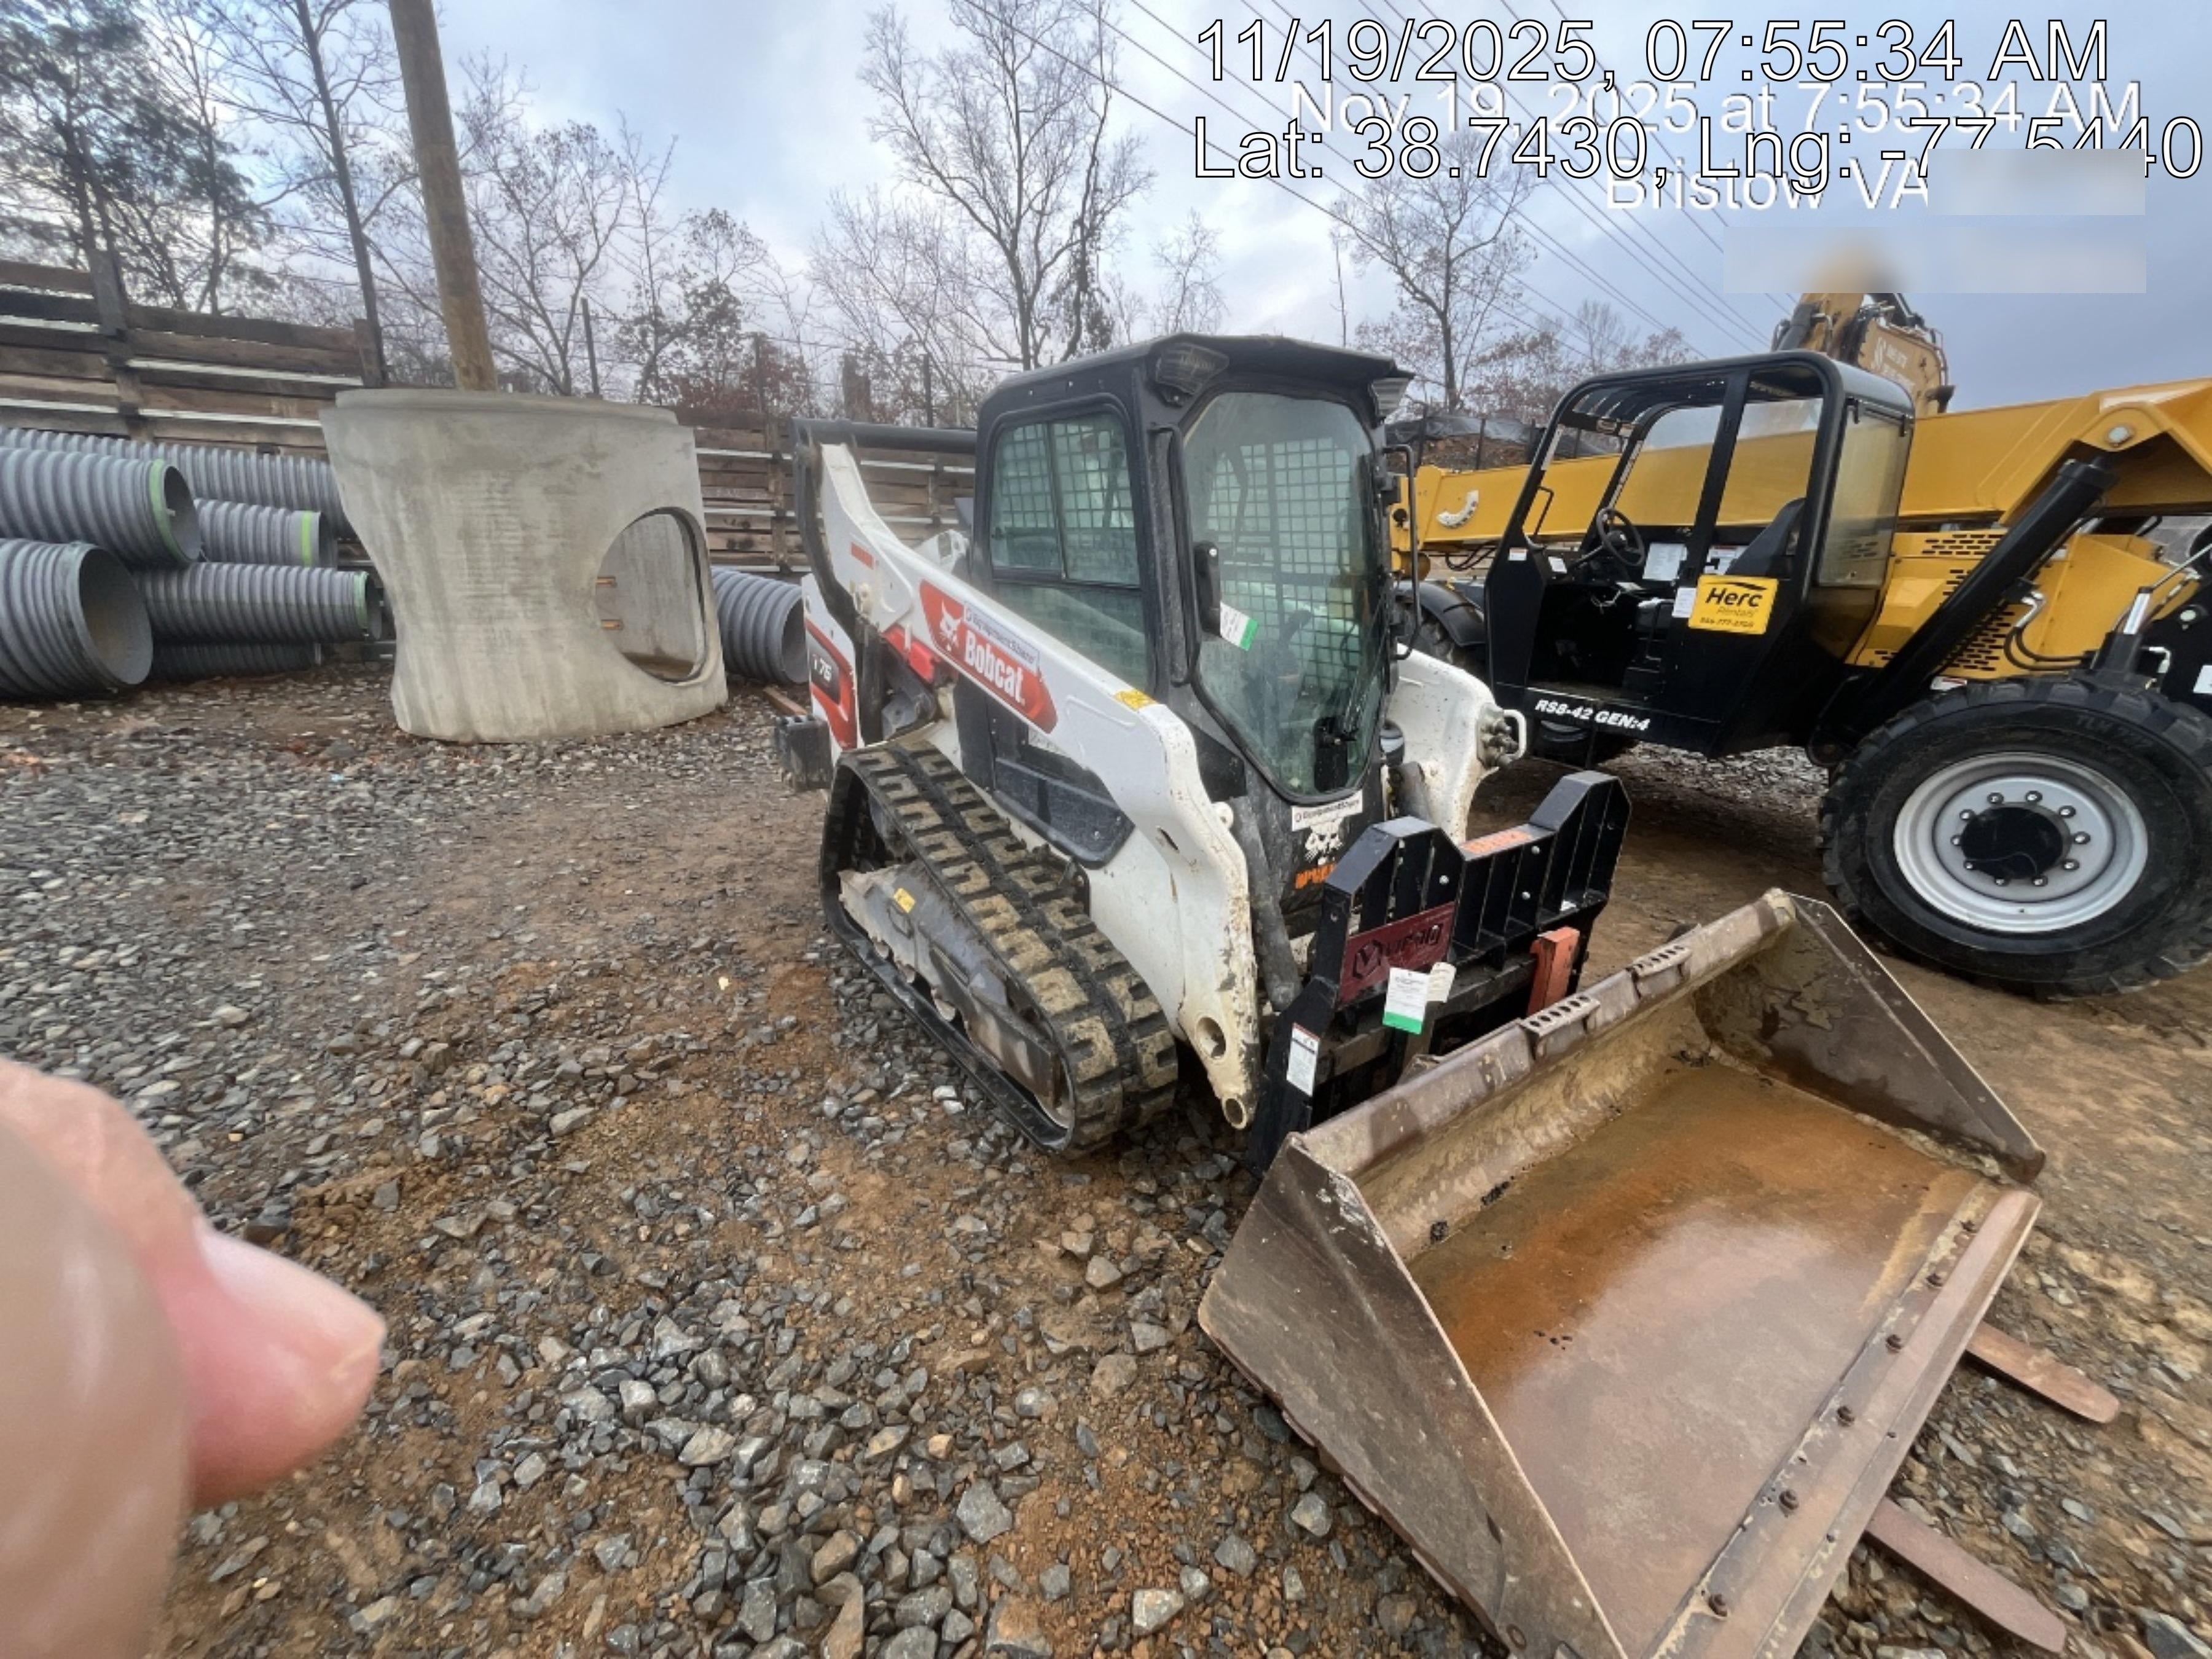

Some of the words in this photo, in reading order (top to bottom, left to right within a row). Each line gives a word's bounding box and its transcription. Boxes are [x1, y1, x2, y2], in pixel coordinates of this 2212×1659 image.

[1705, 587, 1763, 608] Herc
[964, 629, 1024, 704] Bobcat
[1535, 699, 1594, 720] RS8-42
